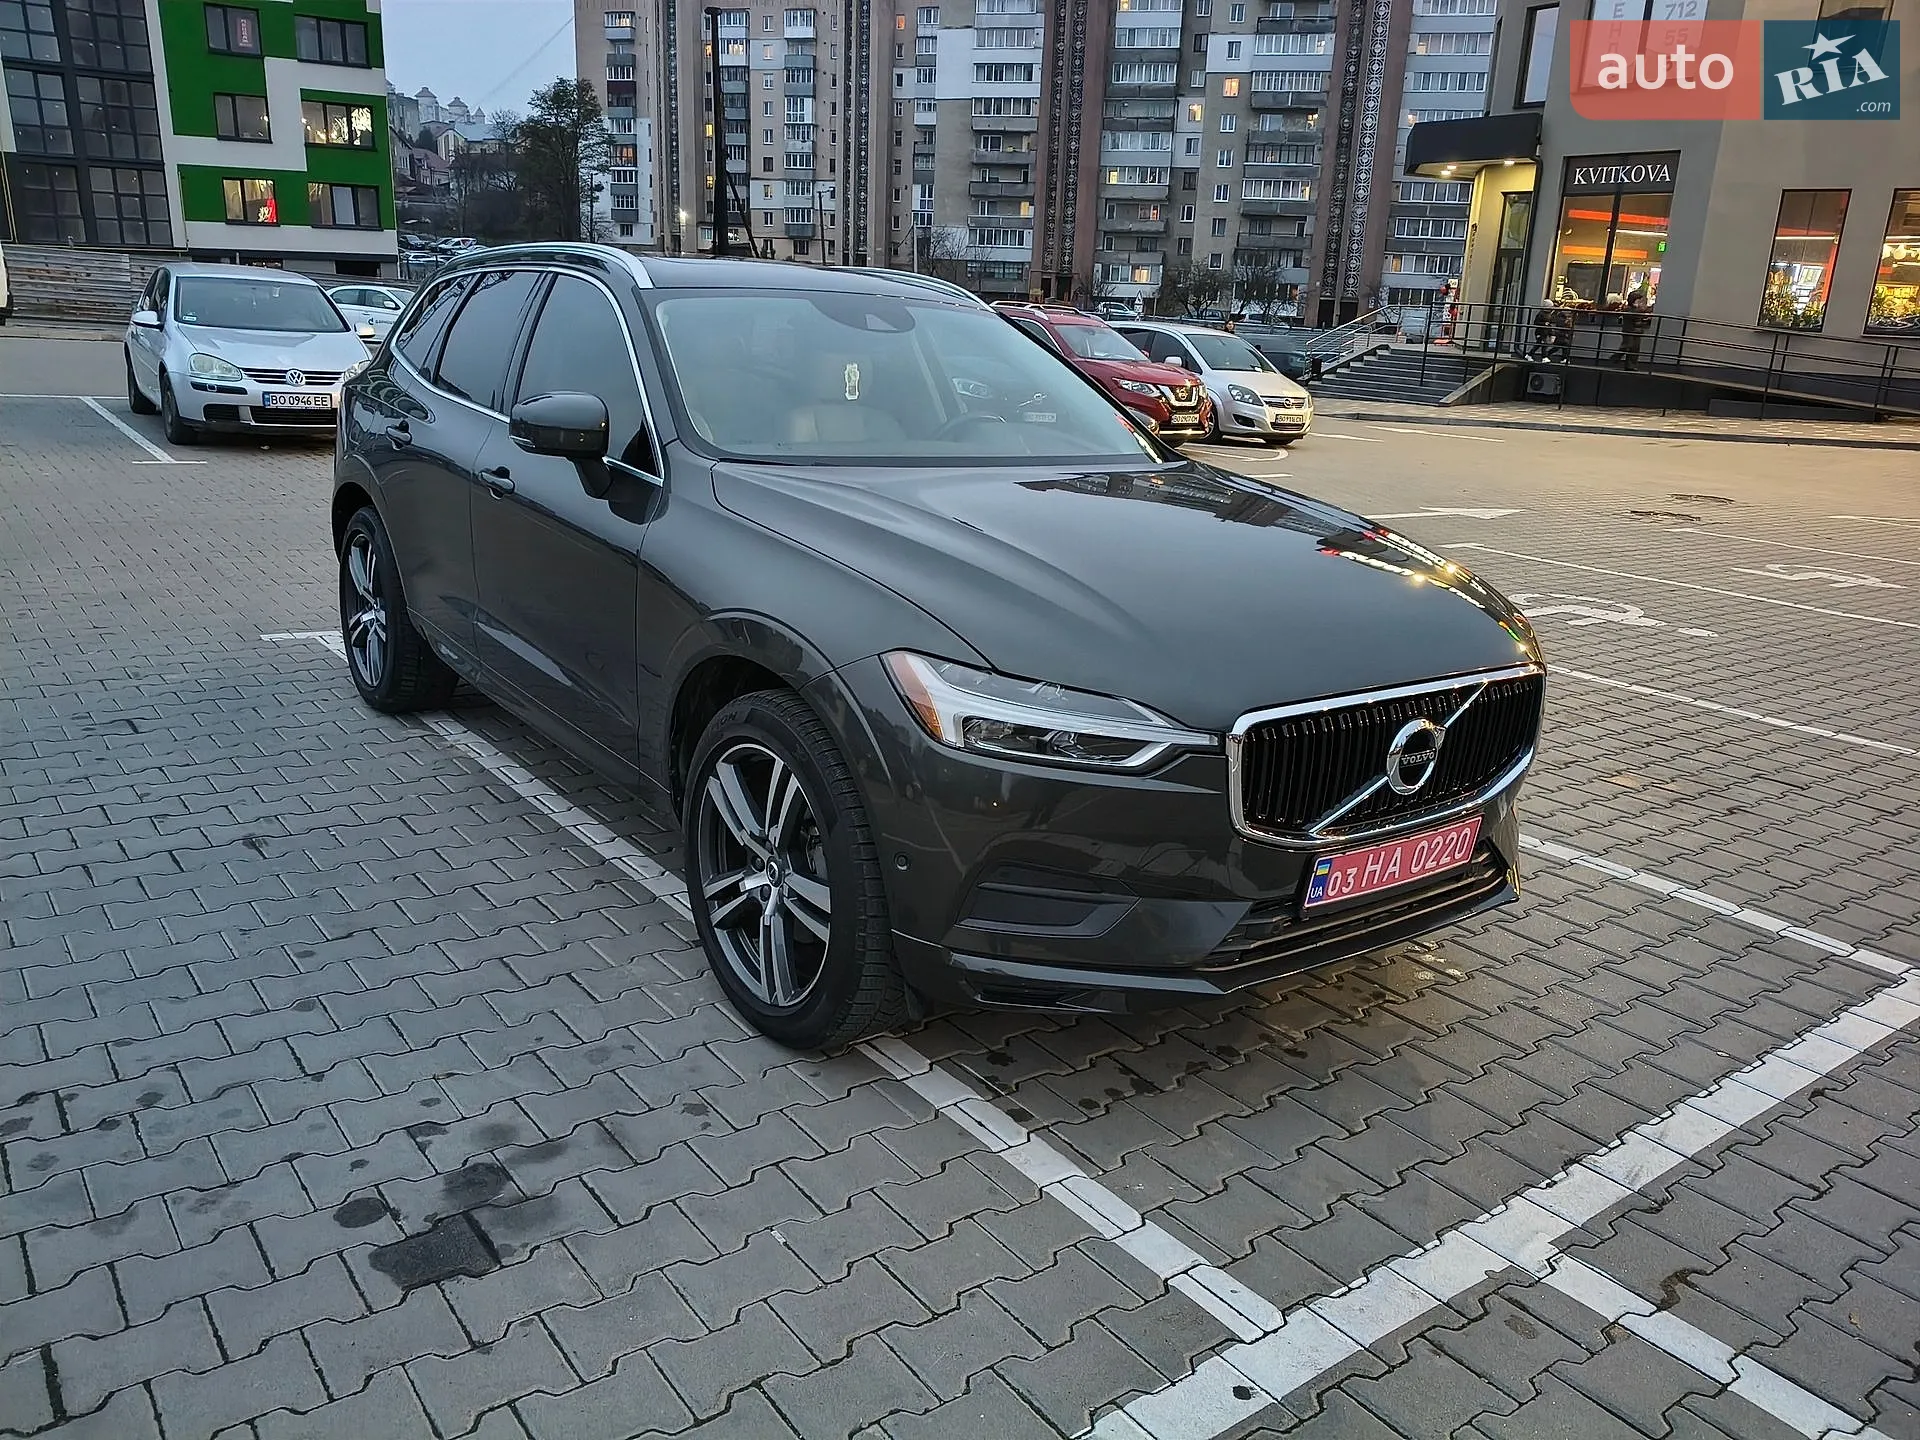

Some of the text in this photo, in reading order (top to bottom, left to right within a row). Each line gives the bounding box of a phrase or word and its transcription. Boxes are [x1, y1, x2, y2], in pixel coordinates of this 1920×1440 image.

[1573, 164, 1672, 185] KVITKOVA
[271, 395, 328, 406] BO 0946 EE
[1400, 751, 1435, 766] VOLVO
[1326, 827, 1472, 897] 03 HA 0220
[1309, 886, 1323, 899] UA
